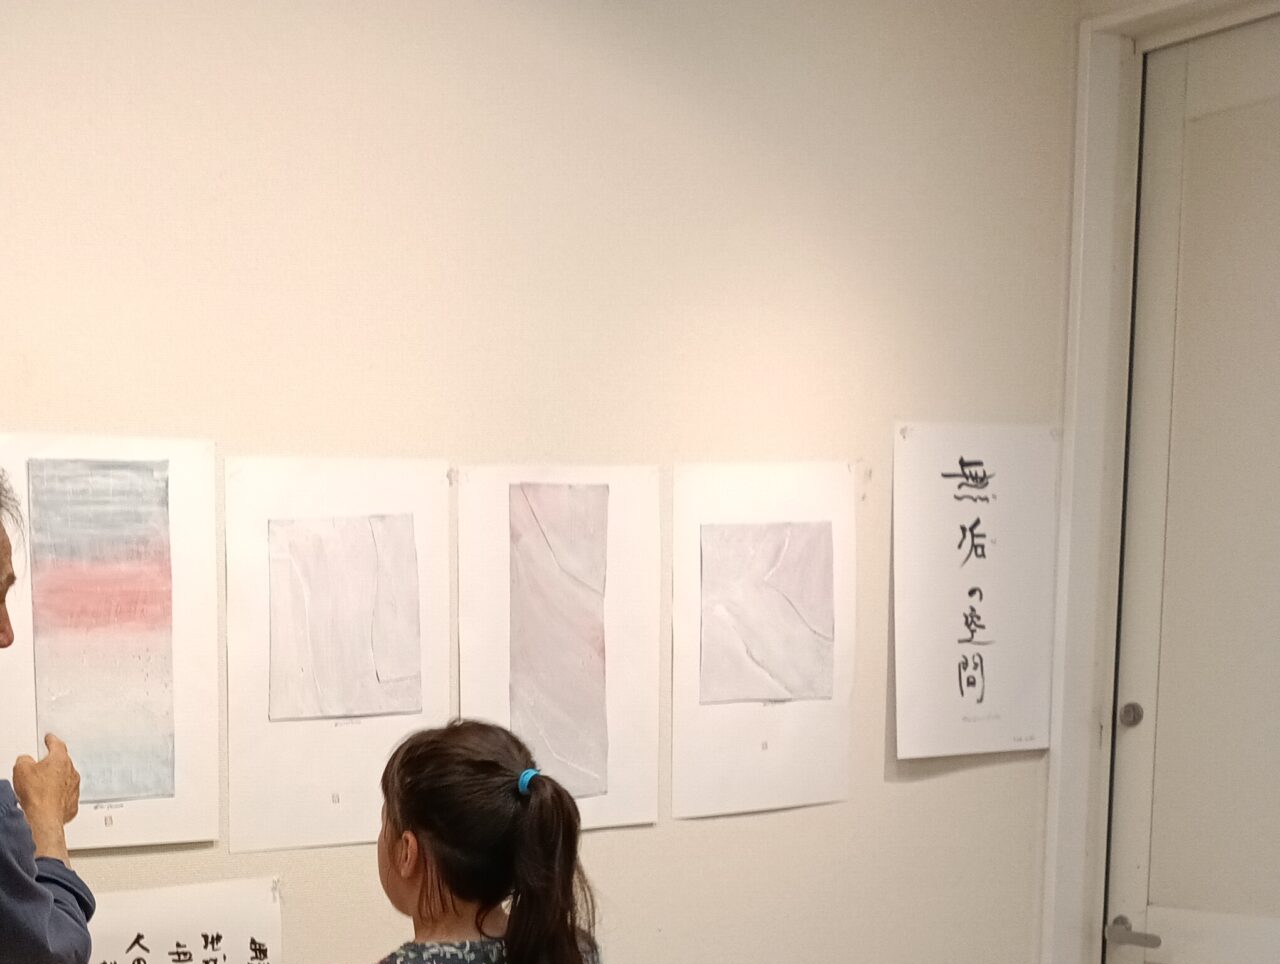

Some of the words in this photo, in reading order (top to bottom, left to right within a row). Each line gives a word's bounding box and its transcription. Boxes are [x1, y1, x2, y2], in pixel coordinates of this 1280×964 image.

[941, 456, 997, 704] 無垢の空間
